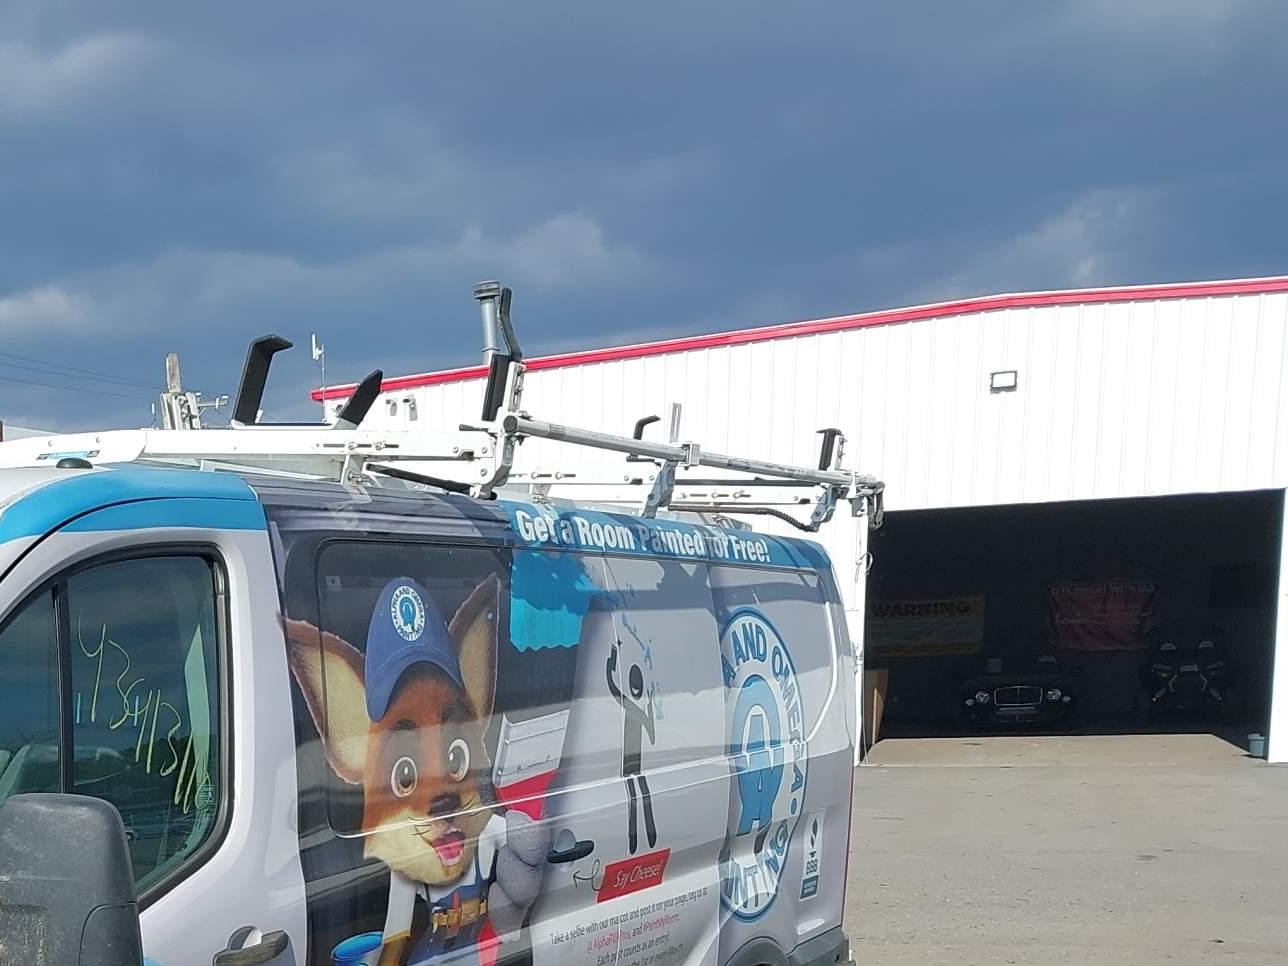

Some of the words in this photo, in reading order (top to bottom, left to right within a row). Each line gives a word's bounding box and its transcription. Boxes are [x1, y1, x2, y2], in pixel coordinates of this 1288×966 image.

[515, 510, 557, 544] Get
[560, 518, 574, 545] a
[574, 516, 635, 552] Room
[638, 526, 706, 558] Painted
[728, 534, 771, 562] Free!
[731, 622, 767, 664] AND
[771, 645, 802, 793] OMEGA
[613, 870, 630, 888] Say
[630, 859, 663, 883] Cheese!
[550, 930, 565, 945] Take
[586, 920, 599, 934] with
[599, 918, 609, 930] our
[630, 907, 640, 921] and
[632, 922, 643, 937] and
